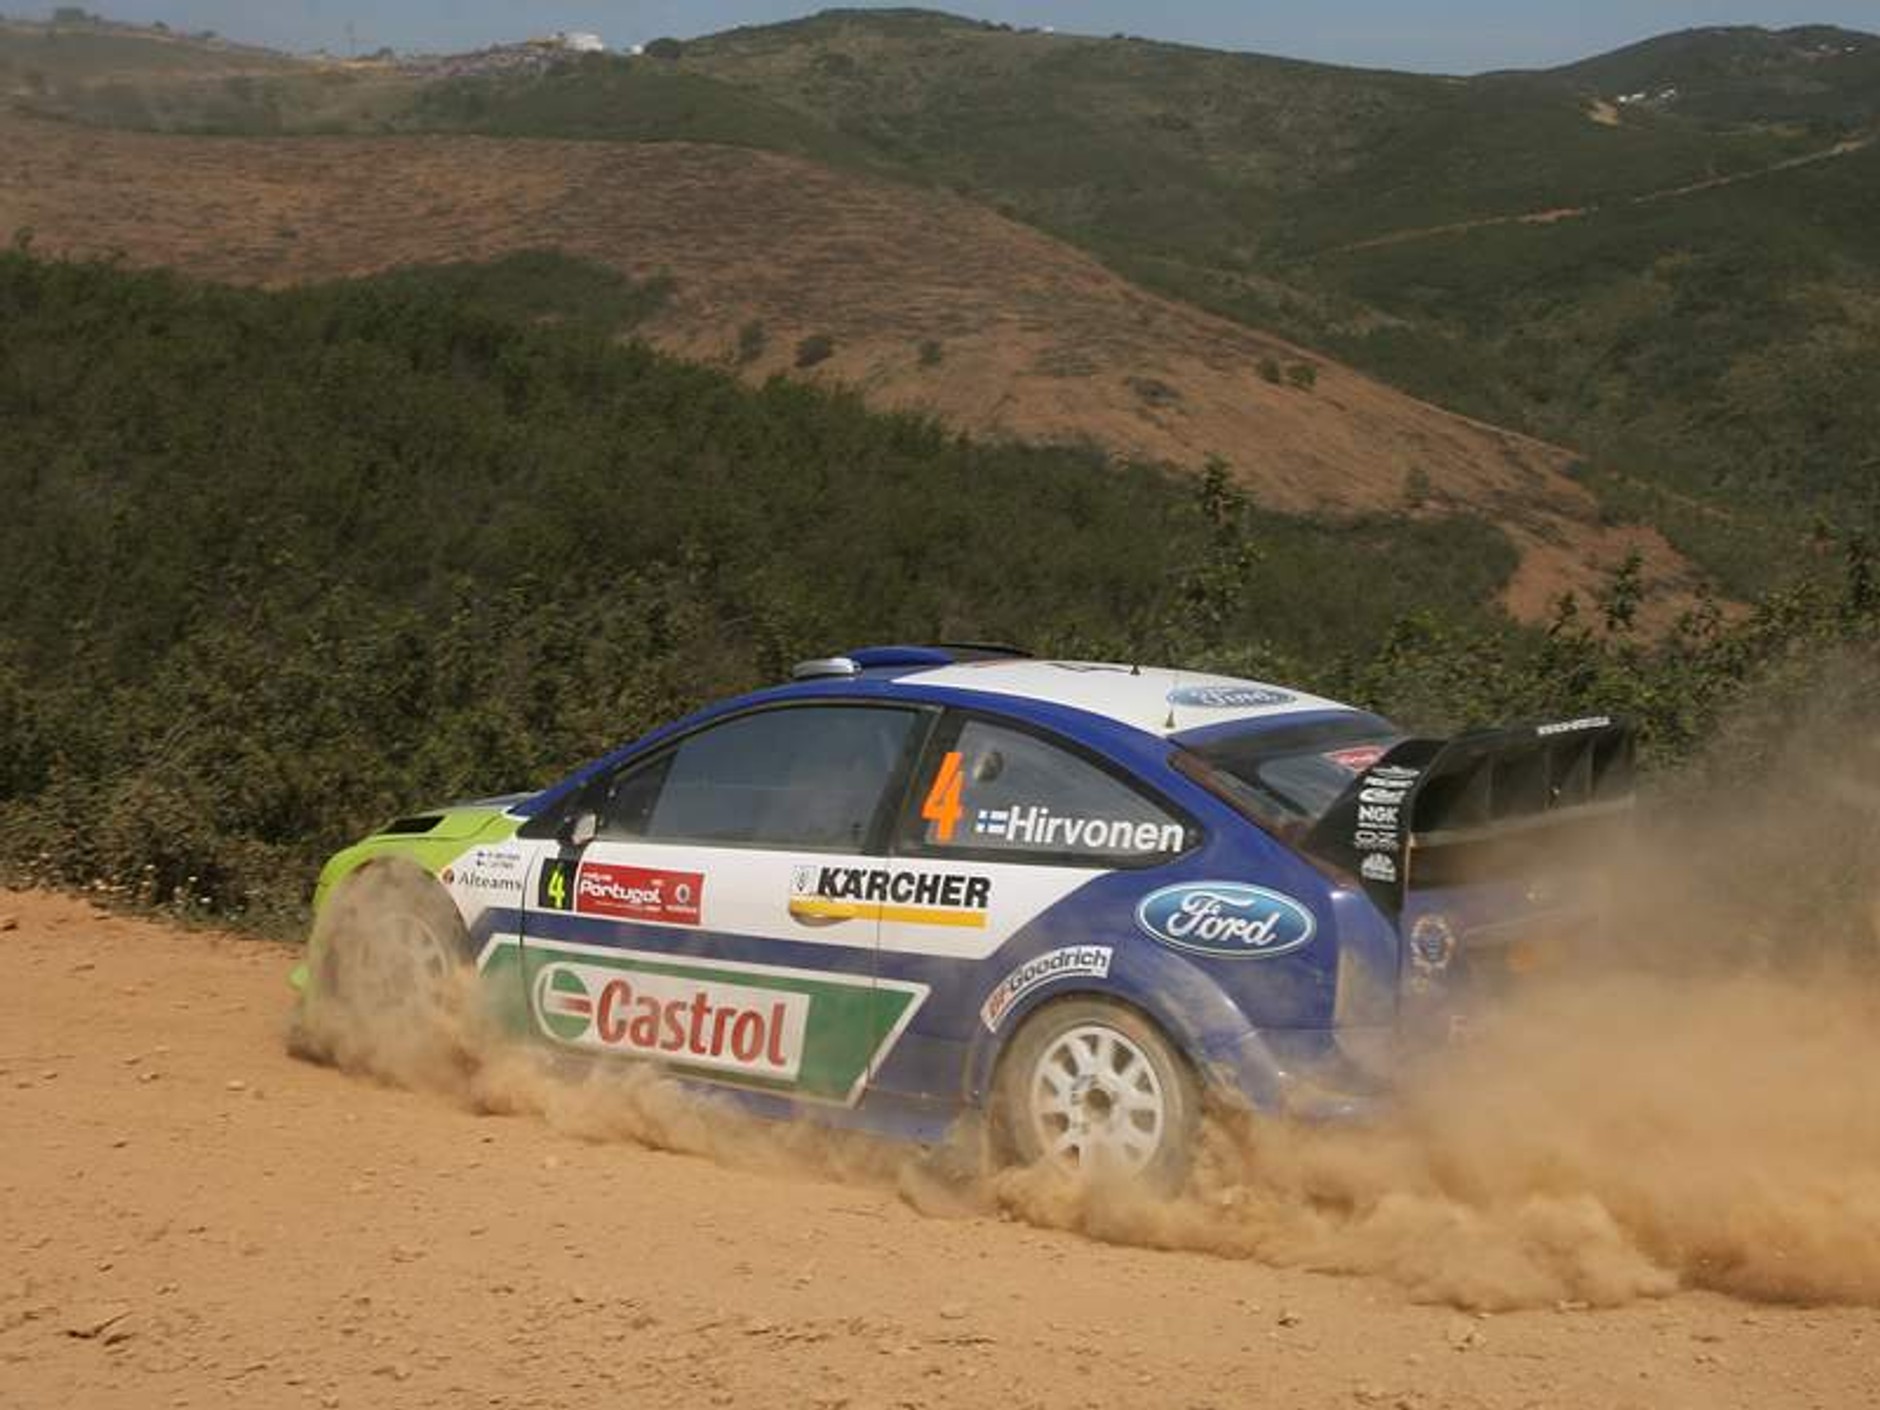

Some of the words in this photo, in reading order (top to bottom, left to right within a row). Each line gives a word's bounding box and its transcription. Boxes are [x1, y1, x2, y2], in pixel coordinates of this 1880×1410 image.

[921, 752, 963, 841] 4
[1359, 805, 1399, 823] NGK
[1006, 806, 1184, 852] Hirvonen
[458, 871, 522, 891] Alteams
[548, 870, 565, 908] 4
[581, 880, 662, 904] Portugal
[817, 867, 991, 908] KÄRCHER
[1167, 891, 1280, 946] Ford
[597, 979, 786, 1066] Castrol
